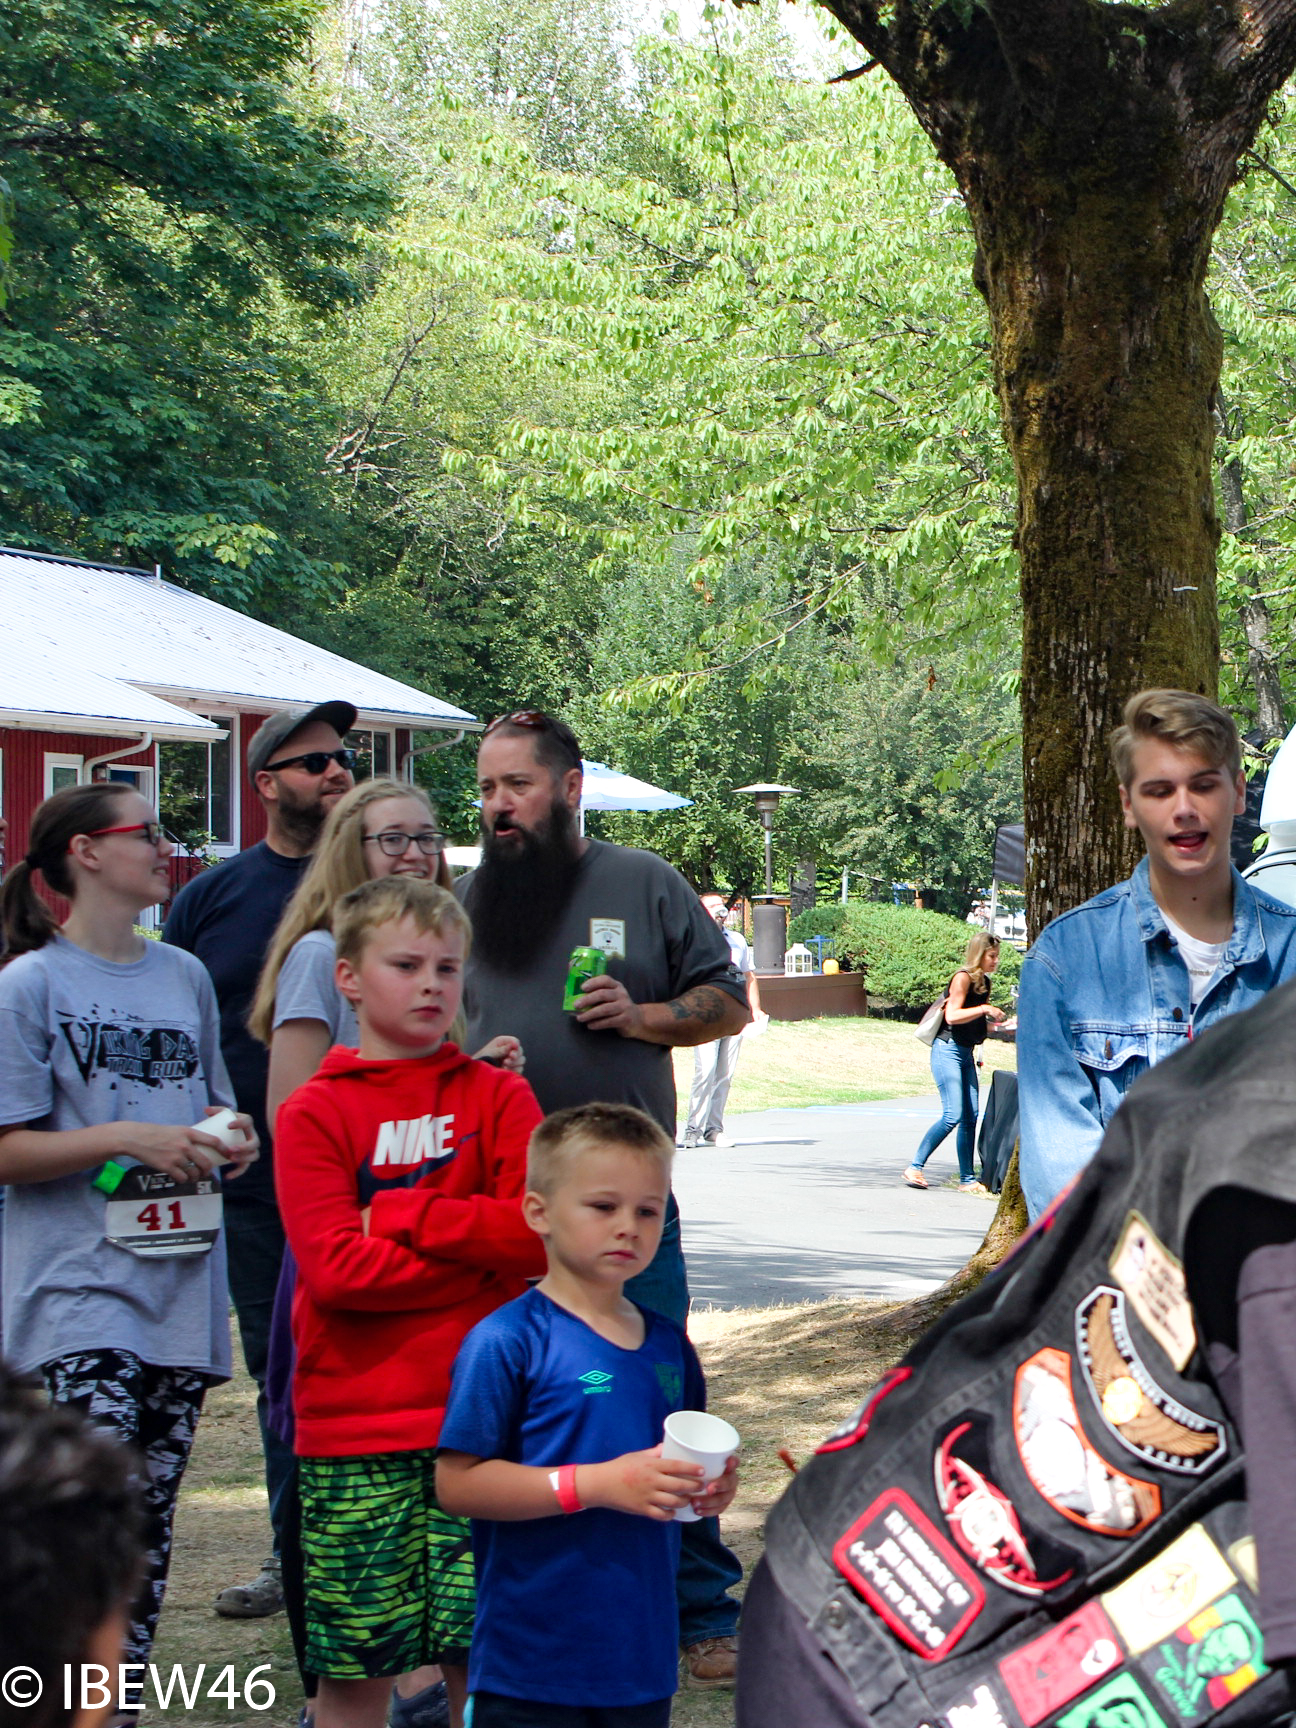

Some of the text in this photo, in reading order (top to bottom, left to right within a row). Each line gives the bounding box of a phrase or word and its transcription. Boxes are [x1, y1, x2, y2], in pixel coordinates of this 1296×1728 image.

[150, 1060, 187, 1078] RUN
[372, 1114, 455, 1166] NIKE
[137, 1201, 187, 1231] 41
